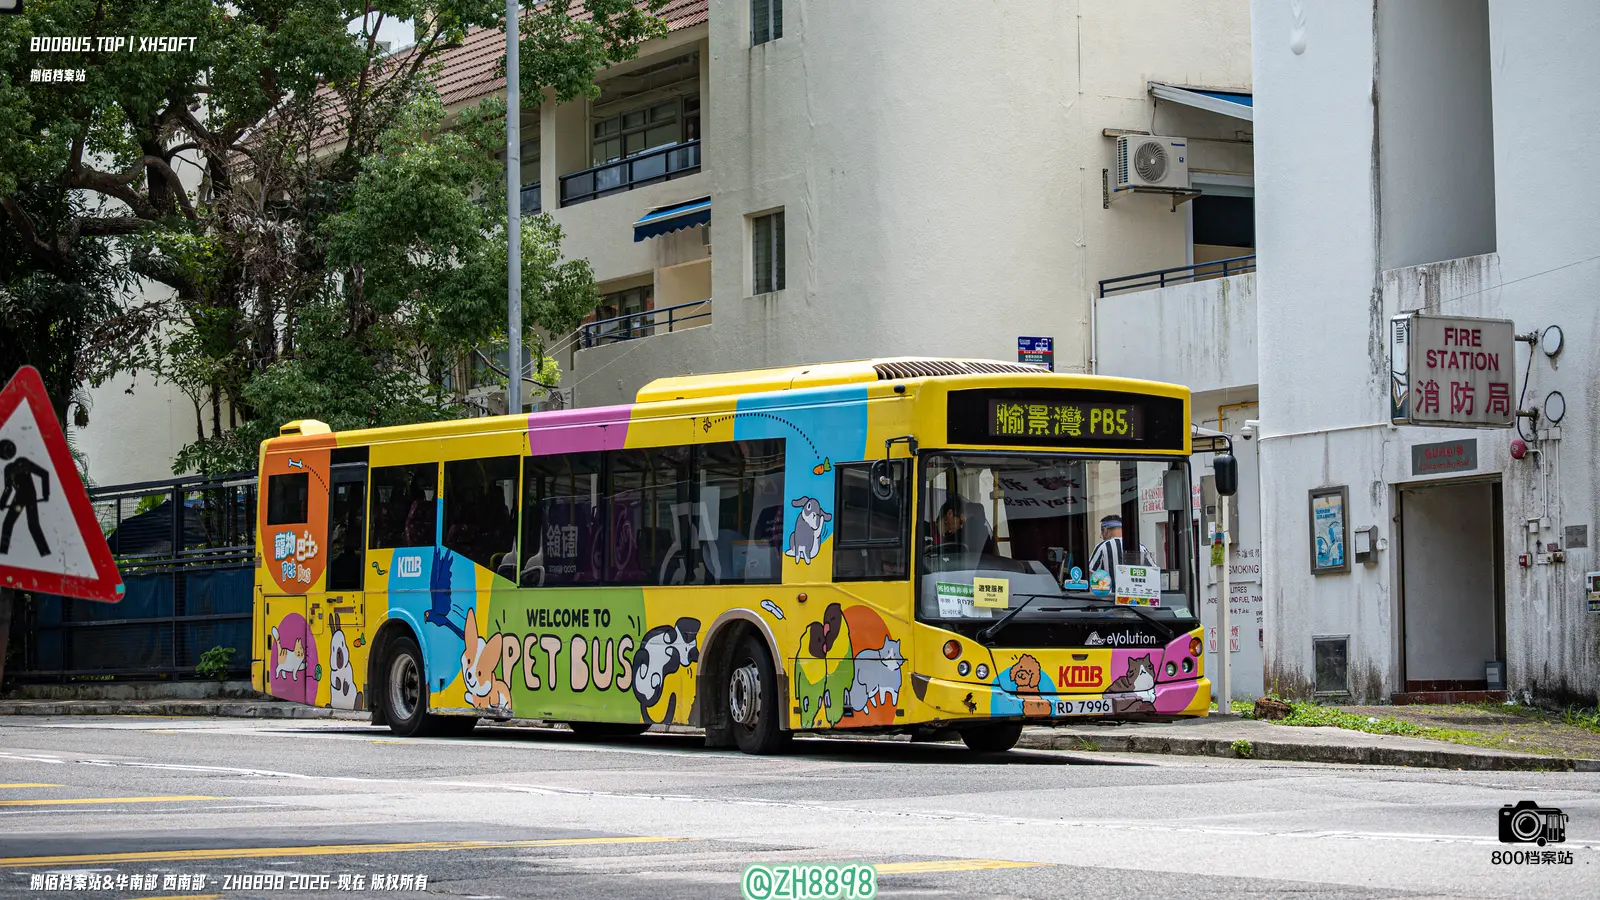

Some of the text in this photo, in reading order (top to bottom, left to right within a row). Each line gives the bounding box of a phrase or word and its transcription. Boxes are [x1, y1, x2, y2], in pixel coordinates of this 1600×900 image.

[1444, 327, 1481, 347] FIRE
[1426, 350, 1499, 371] STATION
[1416, 379, 1510, 416] 消防局
[997, 403, 1128, 436] 愉景灣 PB5
[275, 530, 318, 561] 寵物巴士
[397, 556, 422, 578] KMB
[1132, 568, 1145, 577] PB5
[526, 608, 611, 628] WELCOME TO
[1107, 630, 1156, 647] eVolution
[502, 633, 634, 693] PET BUS
[1058, 665, 1103, 688] KMB
[1057, 700, 1110, 714] RD 7996
